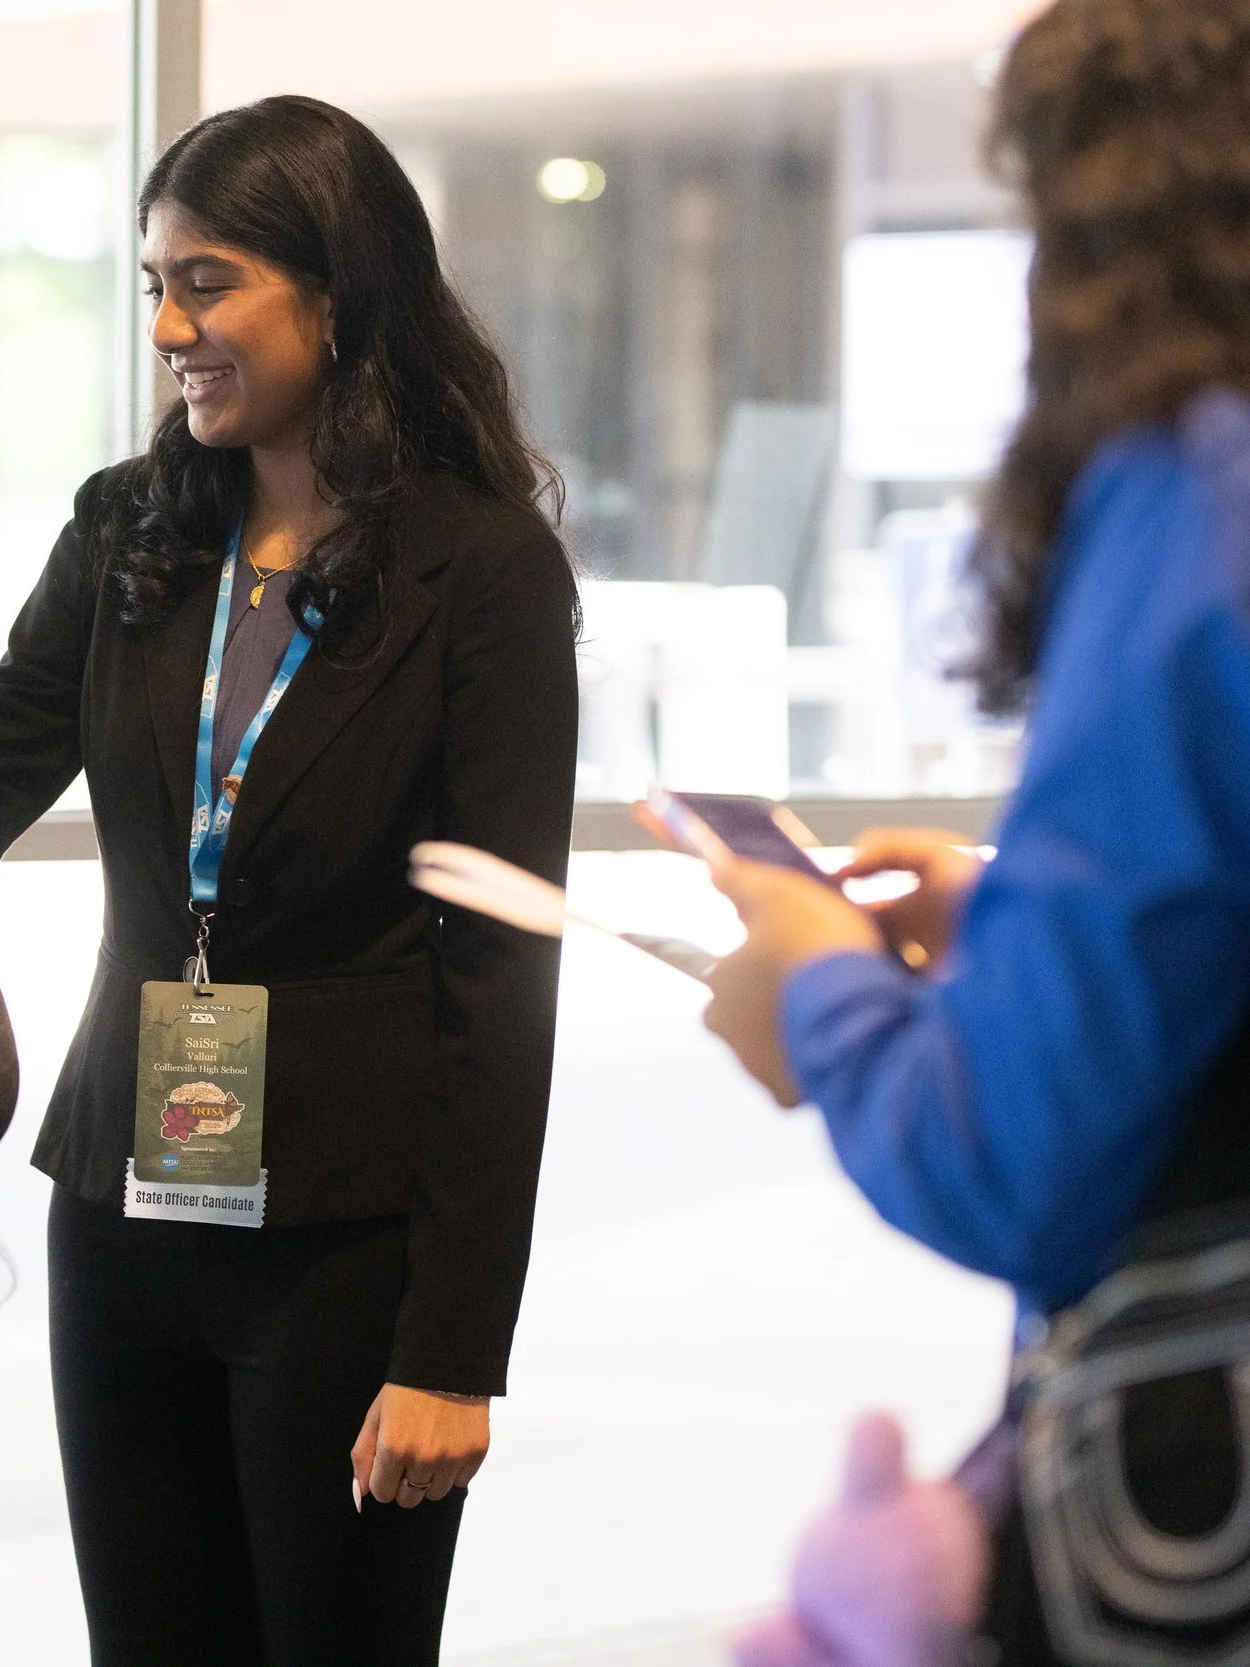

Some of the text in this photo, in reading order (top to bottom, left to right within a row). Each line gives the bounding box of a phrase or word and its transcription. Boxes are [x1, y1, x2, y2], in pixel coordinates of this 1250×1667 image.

[189, 1013, 216, 1024] TSA
[185, 1037, 219, 1050] SaiSri
[187, 1052, 217, 1062] Valluri
[154, 1063, 248, 1075] Collierville High School
[190, 1105, 225, 1117] TNTSA
[135, 1190, 254, 1211] State Officer Candidate
